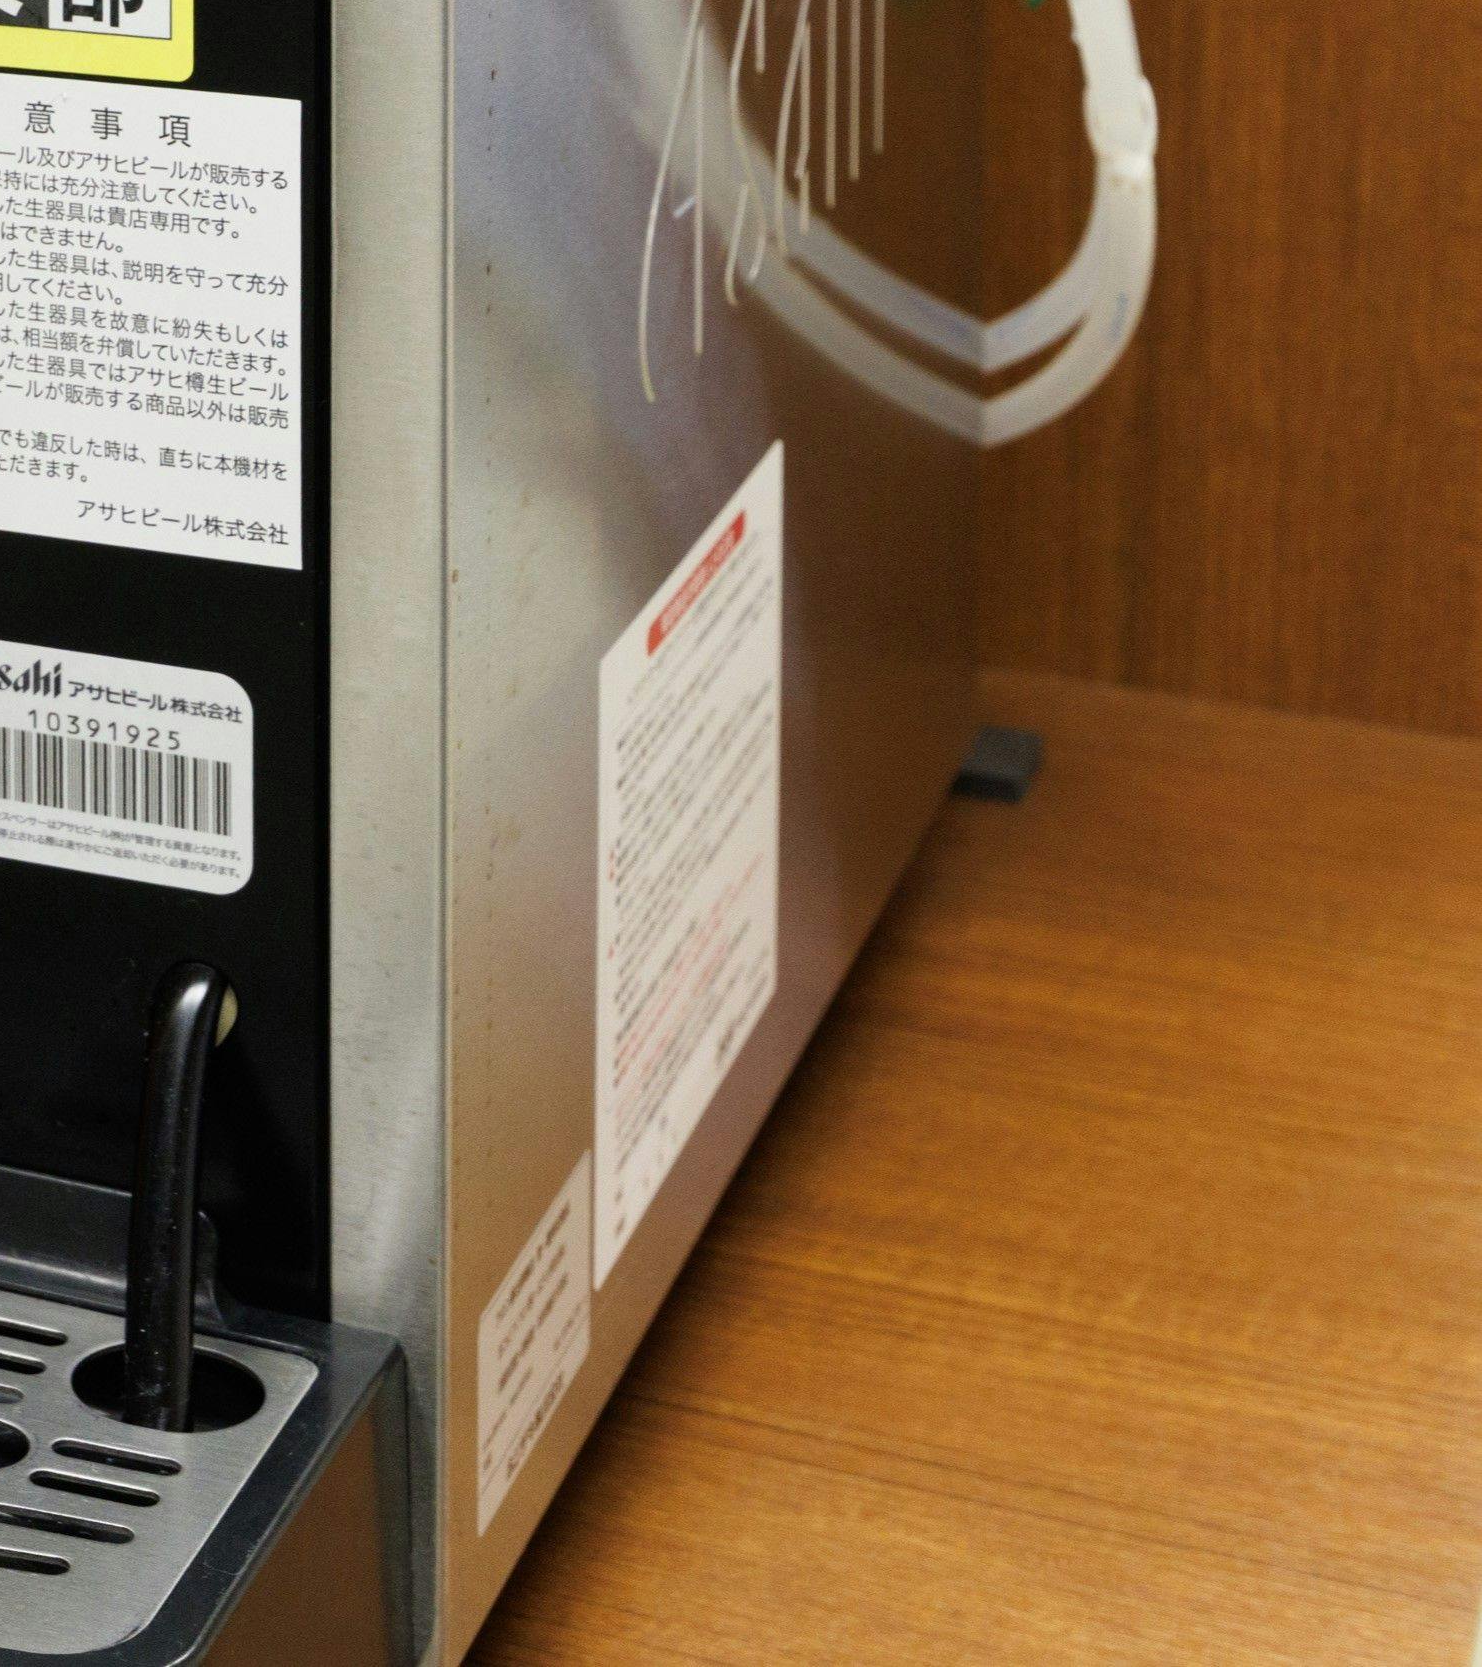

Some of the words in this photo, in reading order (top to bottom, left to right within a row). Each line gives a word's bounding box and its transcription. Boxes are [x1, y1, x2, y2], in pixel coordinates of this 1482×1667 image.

[77, 499, 290, 546] アサヒビール株式会社
[67, 680, 244, 724] アサヒビール株式会社
[28, 709, 182, 750] 10391925
